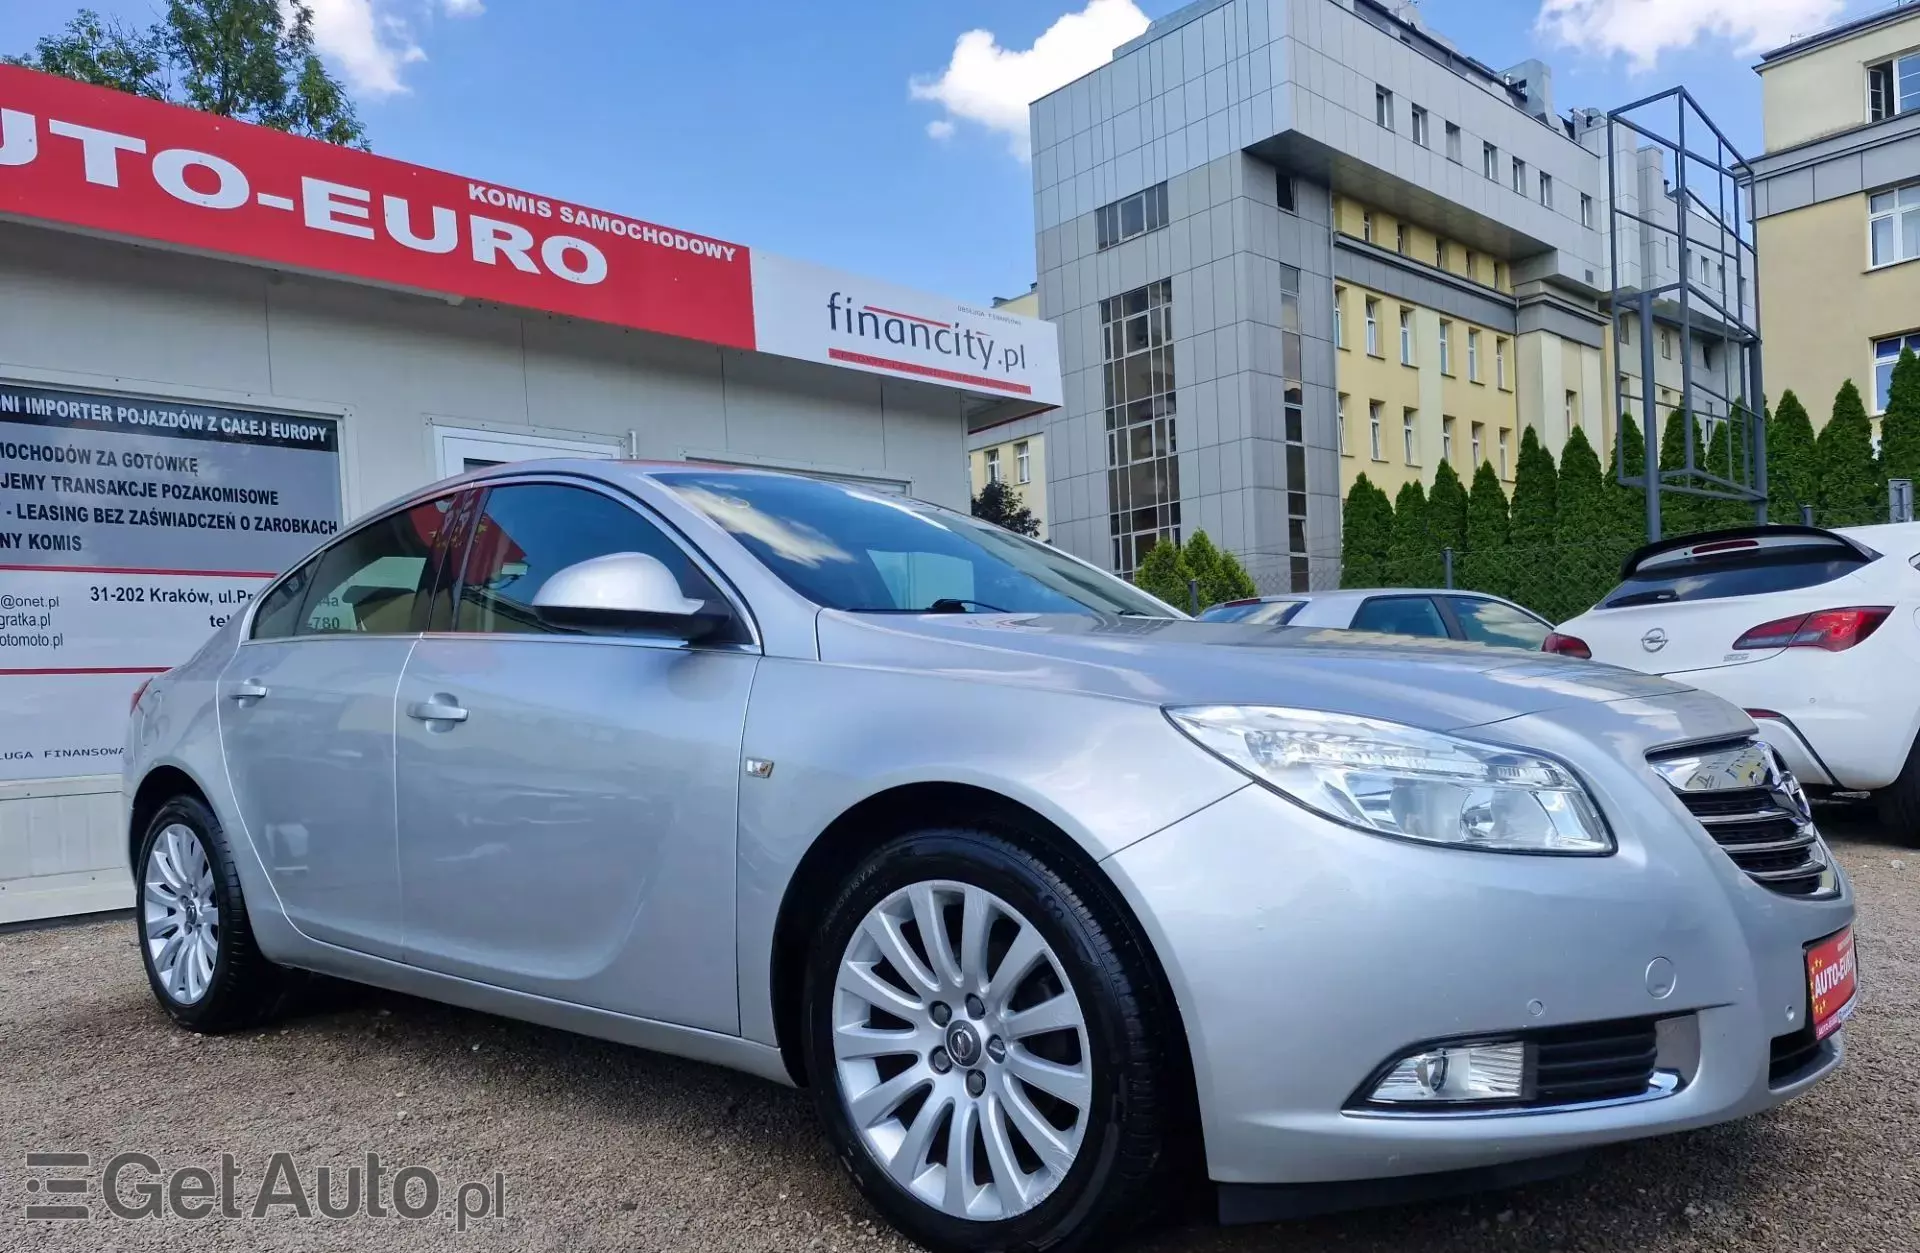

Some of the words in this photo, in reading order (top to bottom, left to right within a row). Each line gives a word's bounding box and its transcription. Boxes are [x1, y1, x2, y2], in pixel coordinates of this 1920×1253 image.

[468, 183, 552, 218] KOMIS
[559, 206, 737, 262] SAMOCHODOWY
[827, 292, 1026, 373] financity.pl
[25, 396, 113, 422] IMPORTER
[117, 406, 204, 431] POJAZDÓW
[207, 416, 218, 432] Z
[221, 417, 267, 437] CAŁEJ
[271, 422, 327, 442] EUROPY
[96, 450, 118, 467] ZA
[122, 452, 199, 476] GOTÓWKĘ
[0, 472, 46, 491] JEMY
[51, 475, 158, 498] TRANSAKCJE
[162, 483, 279, 505] POZAKOMISOWE
[16, 503, 89, 523] LEASING
[93, 507, 124, 525] BEZ
[129, 507, 236, 530] ZAŚWIADCZEŃ
[241, 515, 250, 531] O
[254, 516, 338, 535] ZAROBKACH
[0, 532, 23, 549] NY
[28, 533, 82, 551] KOMIS
[0, 594, 60, 610] @onet.pl
[90, 586, 145, 602] 31-202
[150, 587, 213, 605] Kraków,
[0, 633, 63, 650] otomoto.pl
